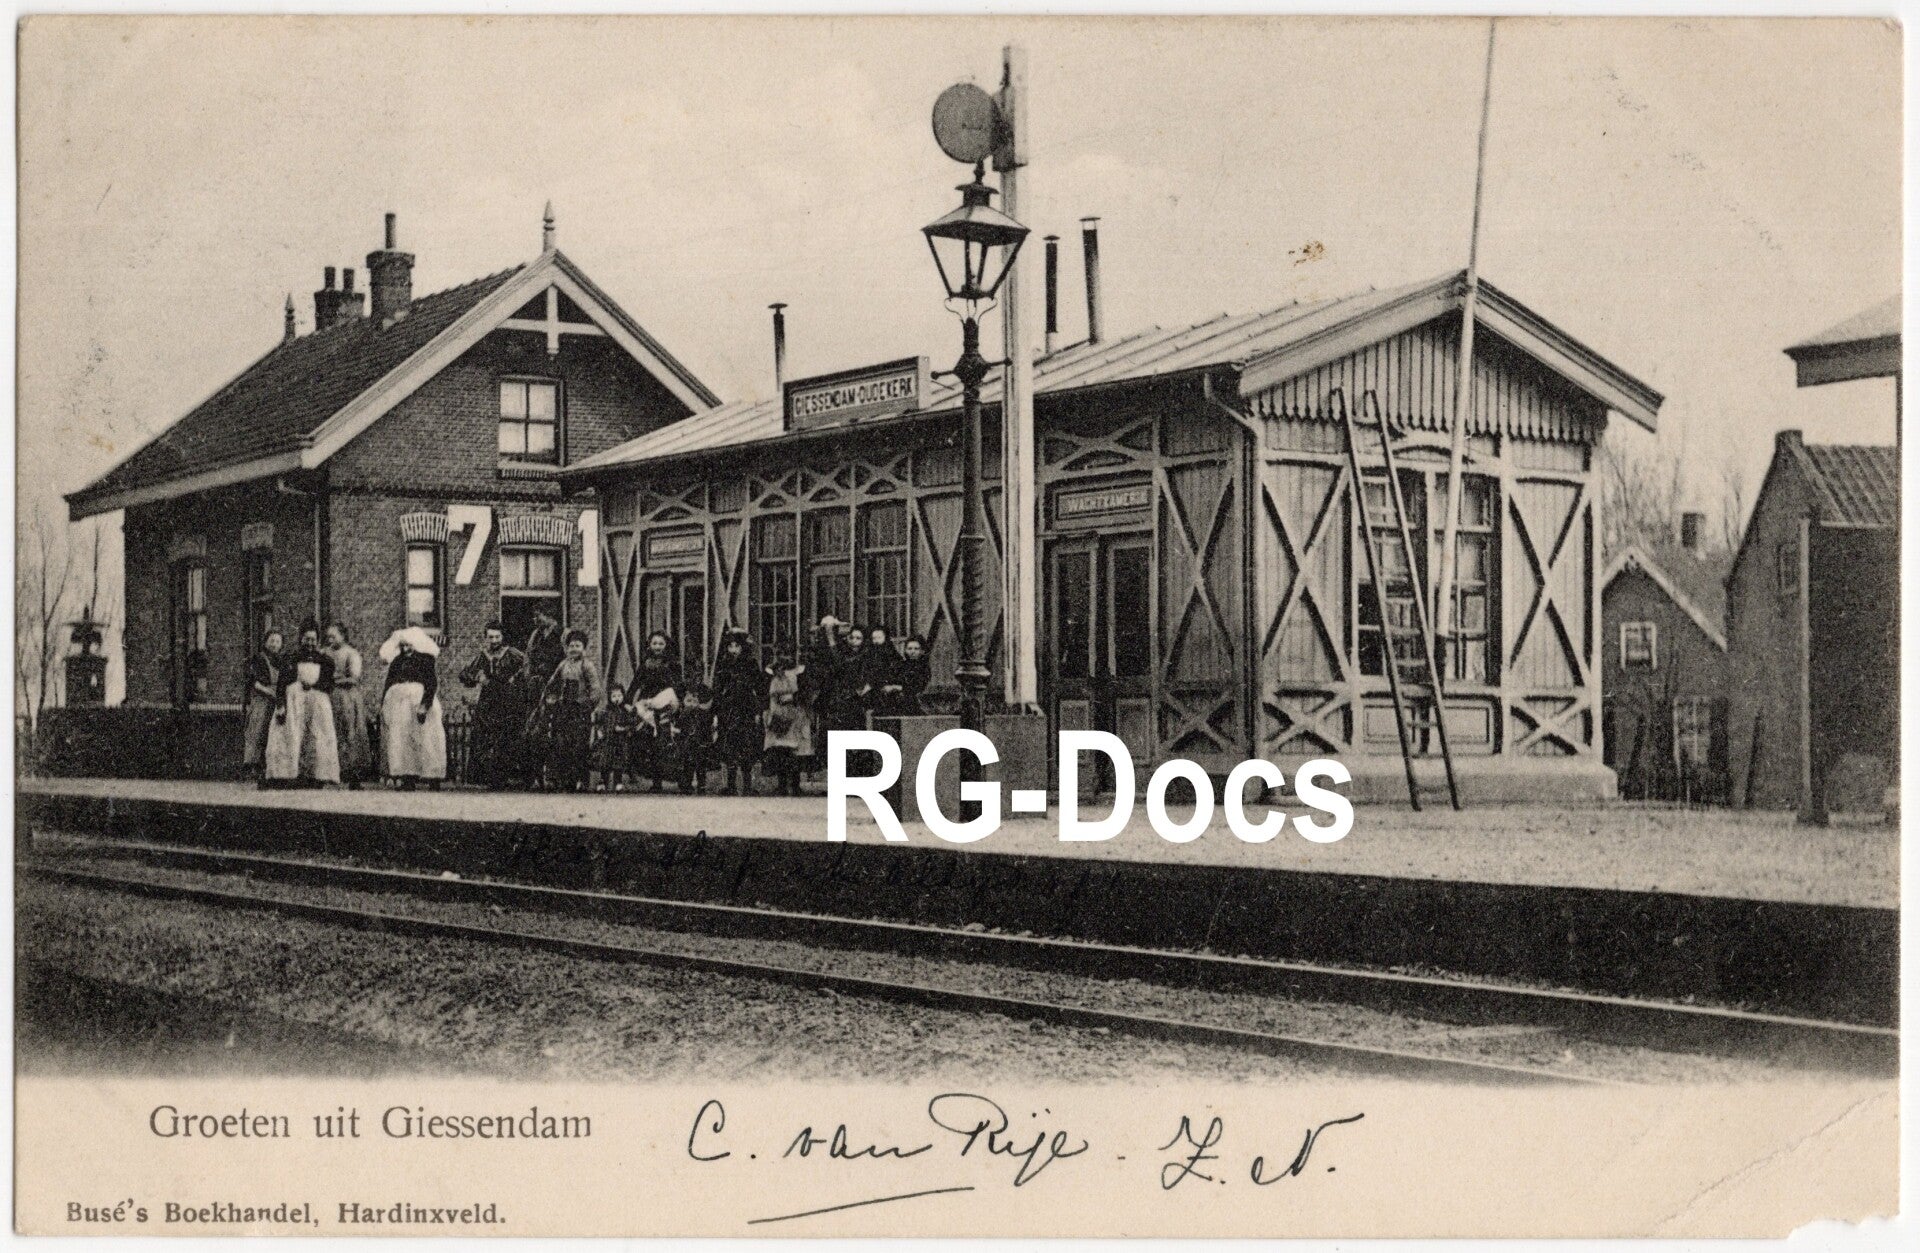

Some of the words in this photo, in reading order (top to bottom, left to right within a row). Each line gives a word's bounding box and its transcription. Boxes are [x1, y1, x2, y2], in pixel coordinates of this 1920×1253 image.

[149, 1104, 291, 1139] Groeten
[313, 1106, 361, 1139] uit
[381, 1105, 591, 1139] Giessendam
[783, 1123, 933, 1160] van
[66, 1198, 149, 1223] Busé's
[164, 1201, 319, 1228] Boekhandel,
[338, 1202, 507, 1225] Hardinxveld.
